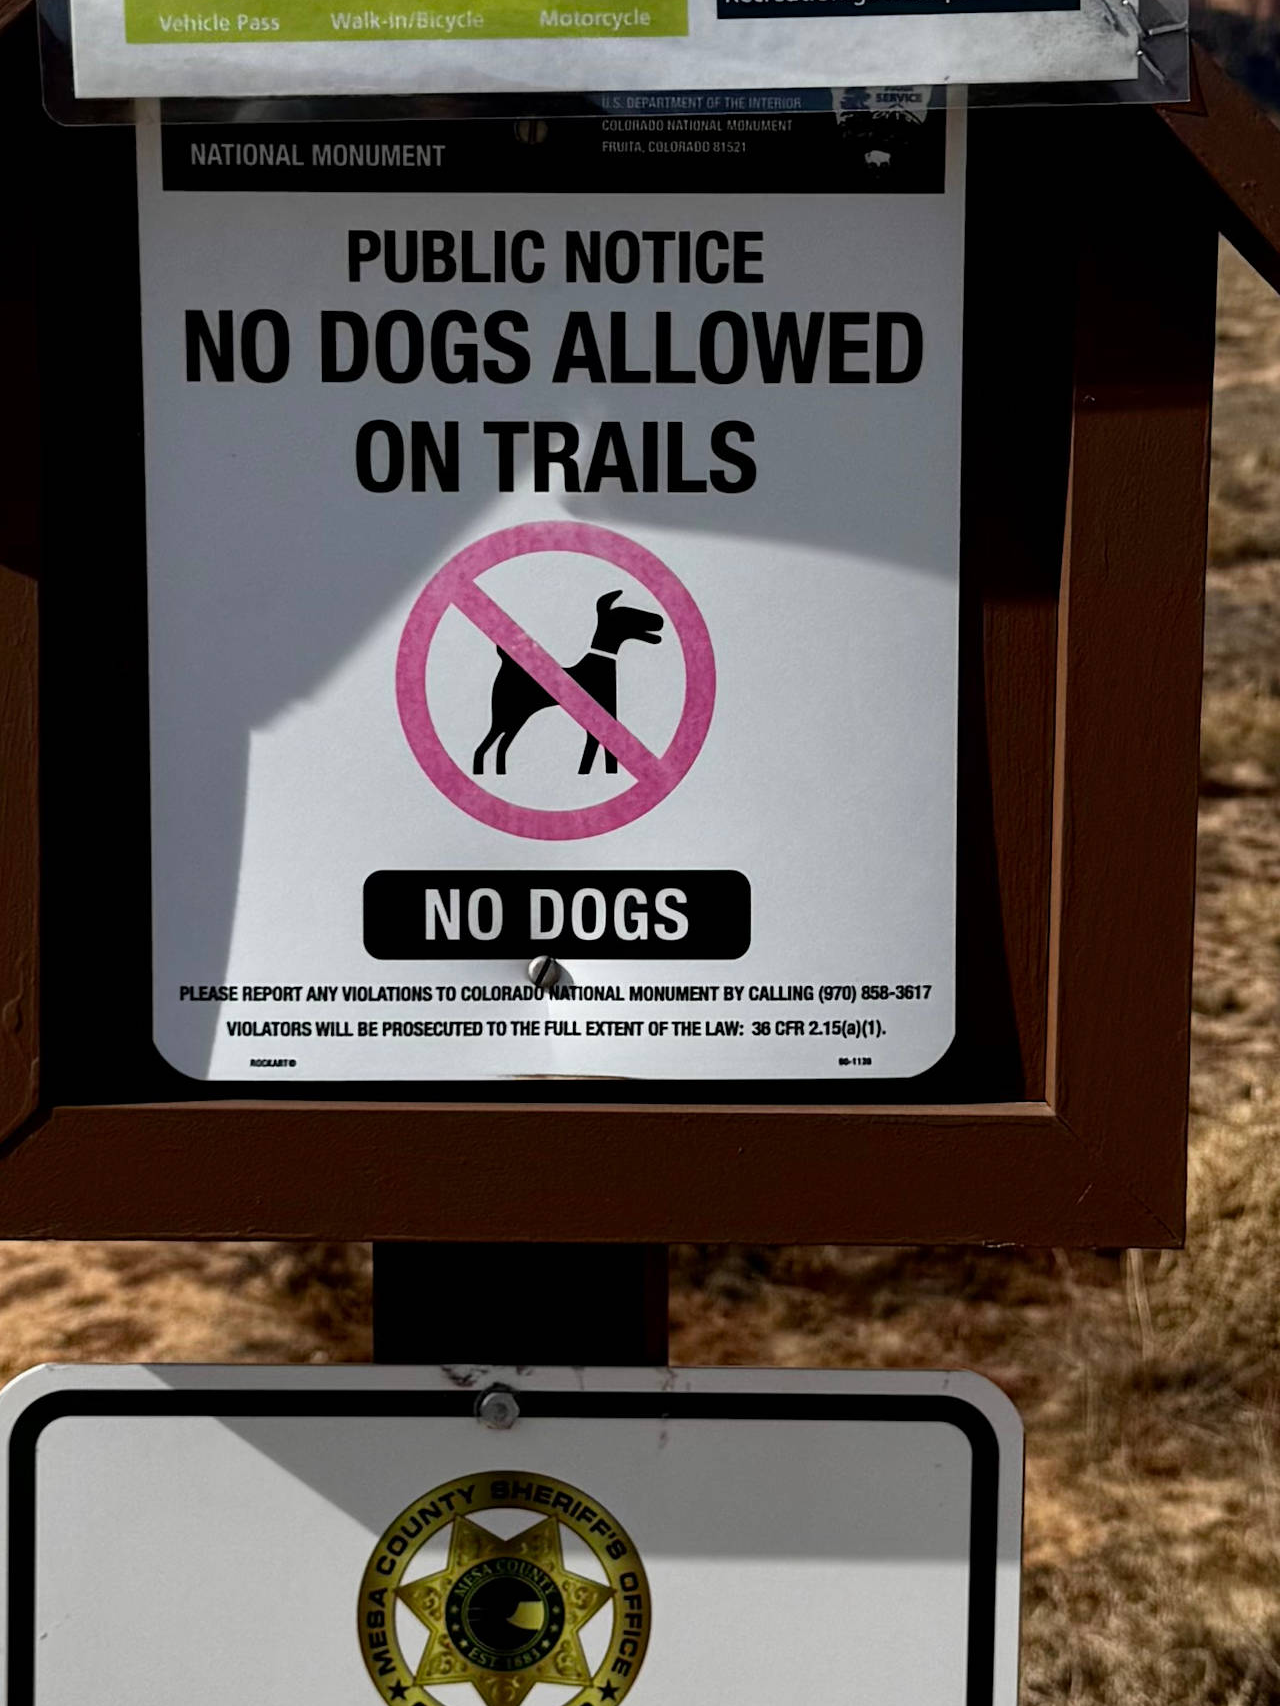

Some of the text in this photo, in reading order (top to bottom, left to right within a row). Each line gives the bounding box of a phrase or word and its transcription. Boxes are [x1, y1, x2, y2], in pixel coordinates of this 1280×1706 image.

[160, 13, 281, 33] Vehicle Pass
[540, 7, 651, 30] Motorcycle
[602, 119, 793, 132] COLORADO NATIONAL MONUMENT
[191, 143, 446, 167] NATIONAL MONUMENT
[648, 141, 711, 153] COLORADO
[713, 141, 747, 153] 81521
[347, 229, 764, 284] PUBLIC NOTICE
[185, 309, 923, 385] NO DOGS ALLOWED
[355, 419, 757, 495] ON TRAILS
[424, 887, 689, 941] NO DOGS
[180, 984, 932, 1004] PLEASE REPORT ANY VIOLATIONS TO COLORADO NATIONAL MONUMENT BY CALLING (970) 858-3617
[226, 1020, 887, 1039] VIOLATORS WILL BE PROSECUTED TO THE FULL EXTENT OF THE LAW: 36 CFR 2.15(a)(1).
[366, 1480, 643, 1677] MESA COUNTY SHERIFF'S OFFICE
